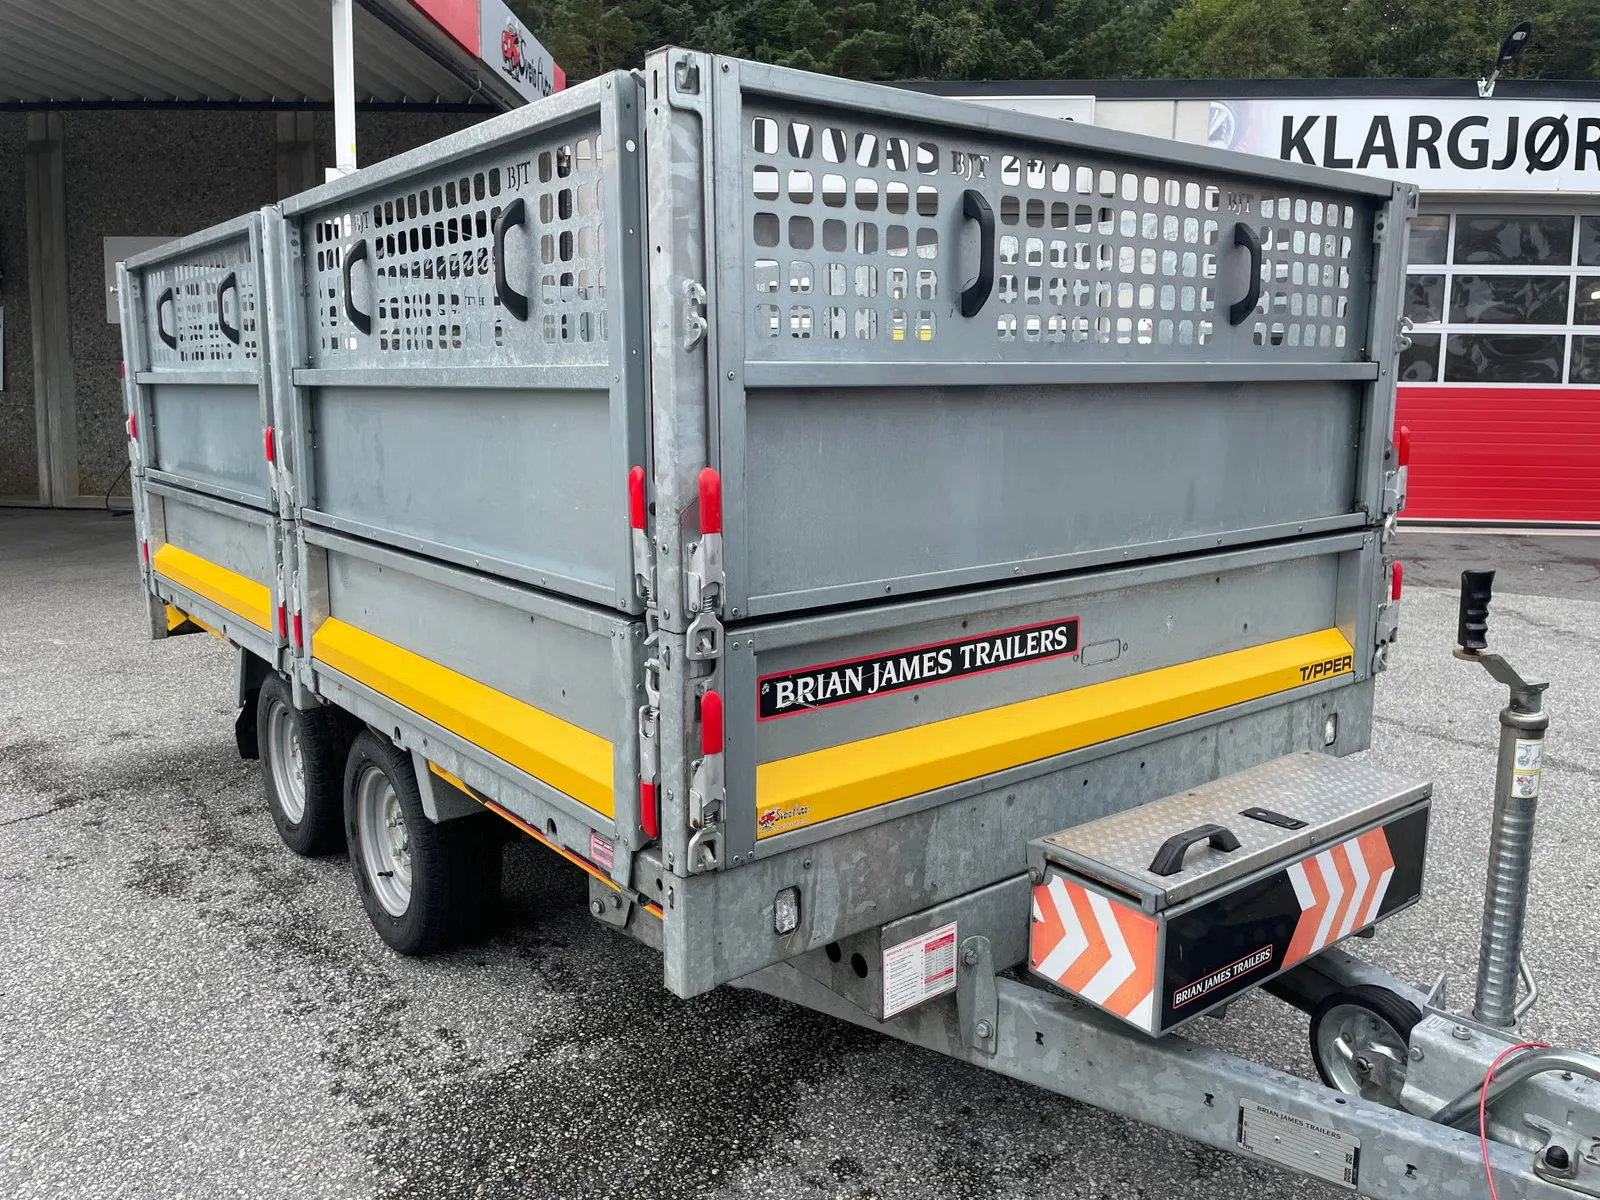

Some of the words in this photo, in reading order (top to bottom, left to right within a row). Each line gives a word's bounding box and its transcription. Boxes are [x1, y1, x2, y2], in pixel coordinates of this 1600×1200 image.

[1280, 114, 1600, 175] KLARGJØR
[507, 161, 530, 191] BJT
[951, 150, 990, 182] BJT
[1227, 191, 1253, 216] BJT
[775, 666, 863, 709] BRIAN
[868, 649, 952, 694] JAMES
[959, 626, 1068, 669] TRAILERS
[1175, 983, 1203, 1004] BRIAN
[1203, 969, 1231, 993] JAMES
[1232, 948, 1271, 976] TRAILERS
[1256, 1105, 1279, 1118] BRIAN
[1280, 1113, 1304, 1127] JAMES
[1305, 1122, 1342, 1140] TRAILERS
